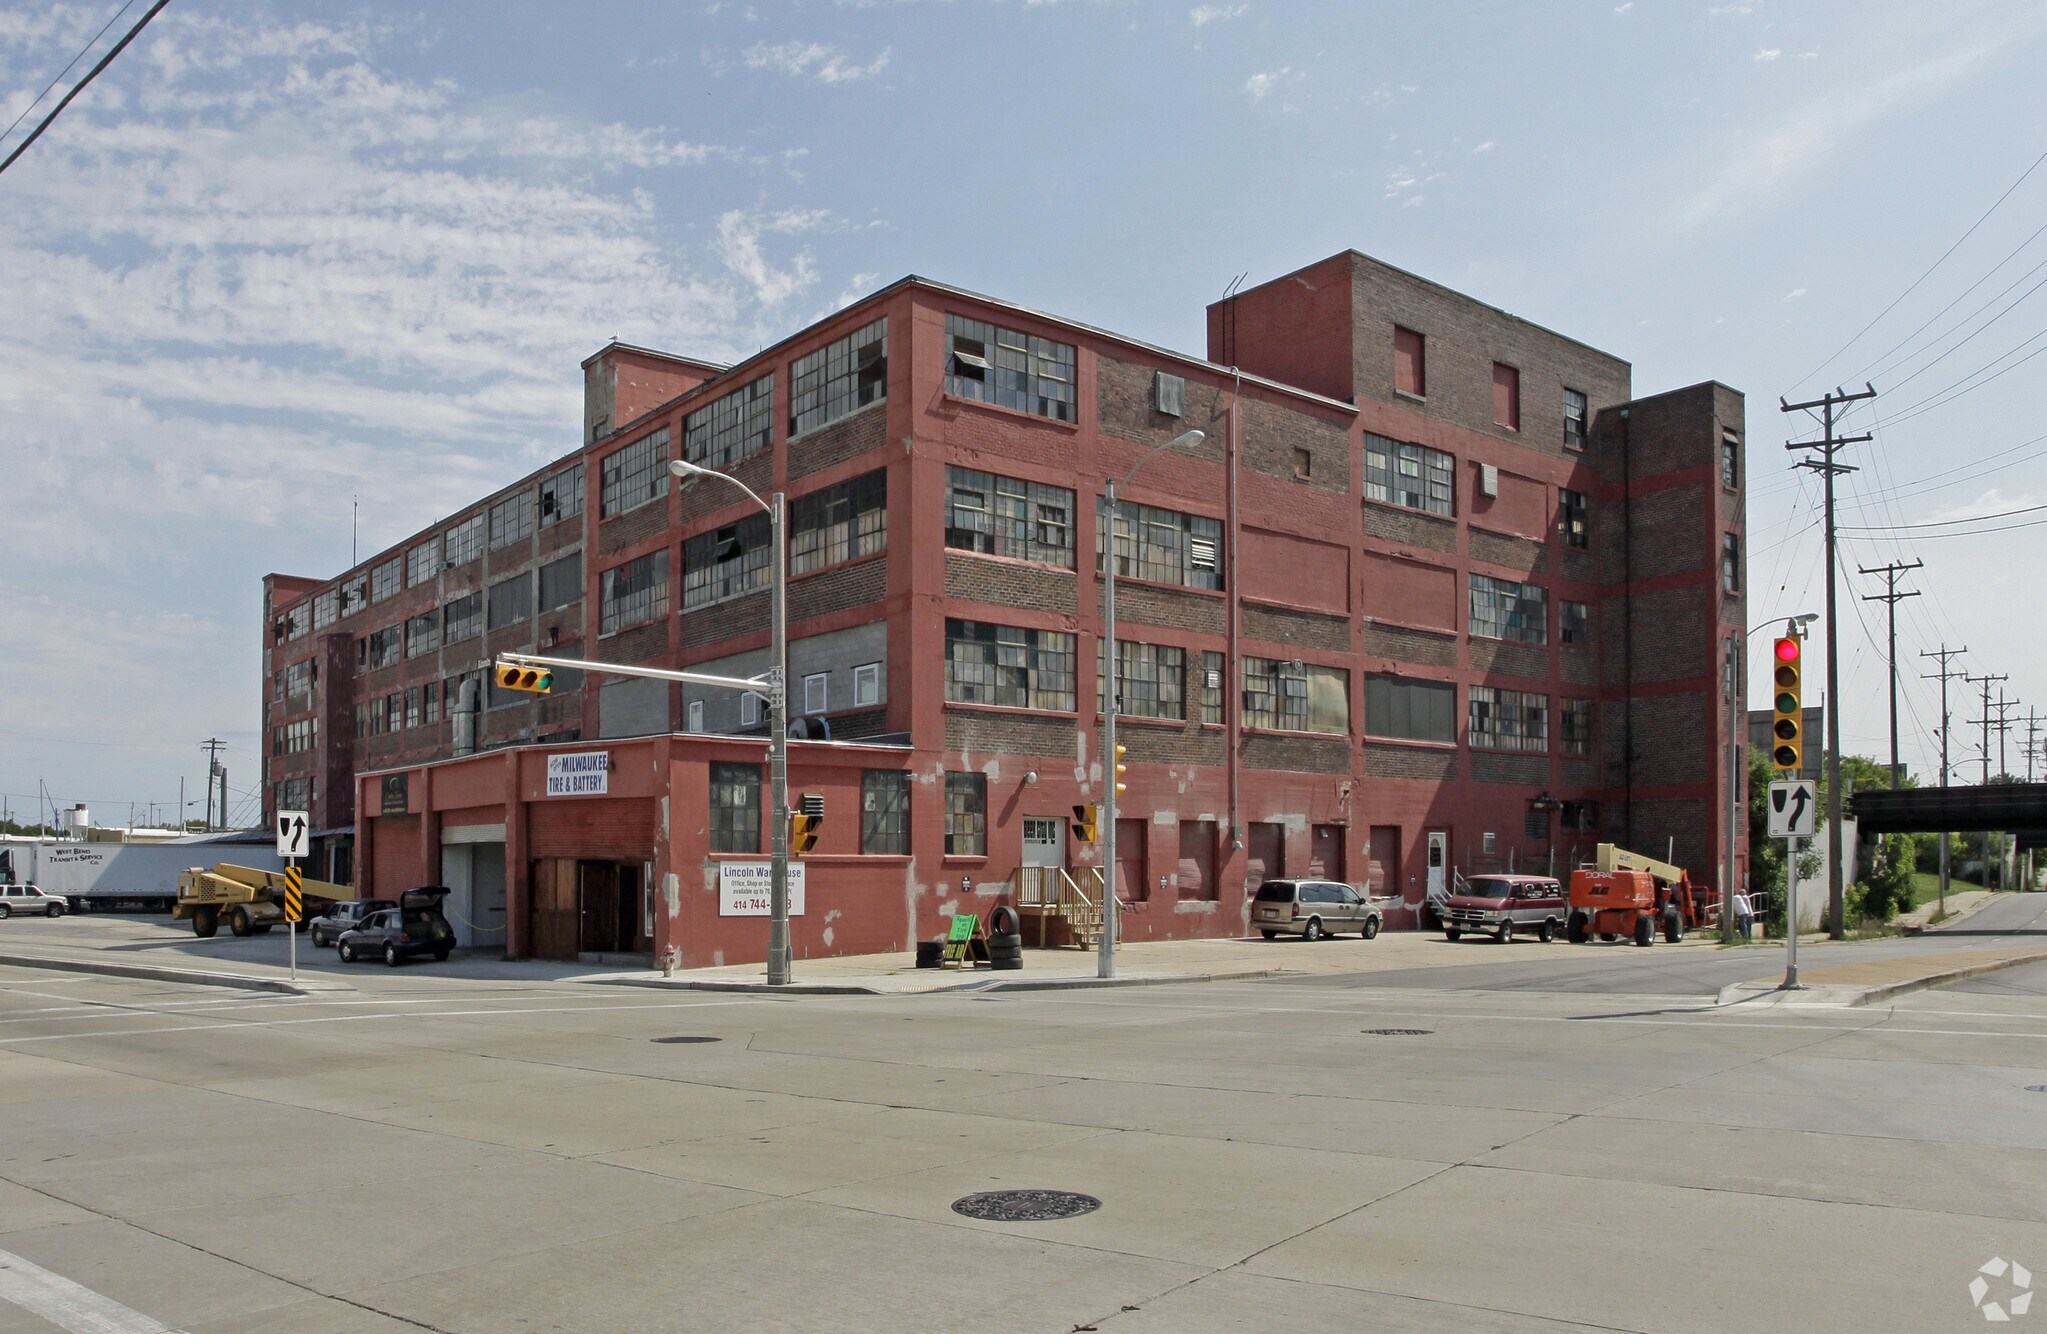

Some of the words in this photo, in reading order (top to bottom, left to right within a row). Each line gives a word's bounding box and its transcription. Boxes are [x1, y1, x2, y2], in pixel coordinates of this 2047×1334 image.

[561, 754, 607, 772] MILWAUKEE
[549, 776, 563, 792] TIRE
[566, 776, 570, 792] &
[573, 774, 602, 792] BATTERY
[724, 867, 754, 878] Lincoln
[1588, 886, 1610, 895] JLG
[733, 900, 747, 910] 414
